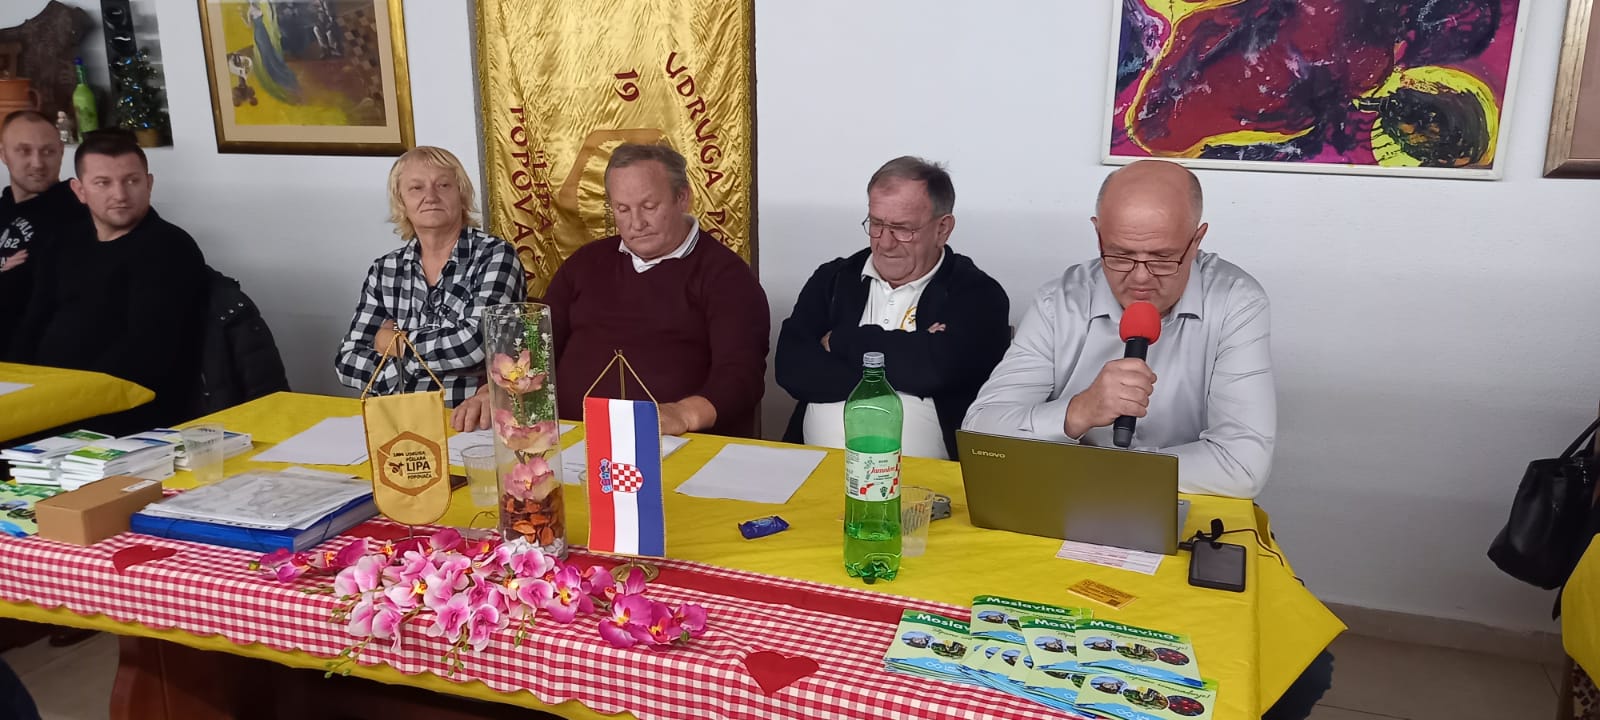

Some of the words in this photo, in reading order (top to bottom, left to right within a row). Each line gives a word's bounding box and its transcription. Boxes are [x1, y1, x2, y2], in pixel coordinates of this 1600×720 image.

[614, 68, 640, 102] 19
[666, 52, 724, 189] UDRUGA
[971, 448, 1005, 458] Lenovo
[406, 461, 430, 471] LIPA
[986, 597, 1066, 614] Moslavina
[1090, 620, 1175, 640] Moslavina
